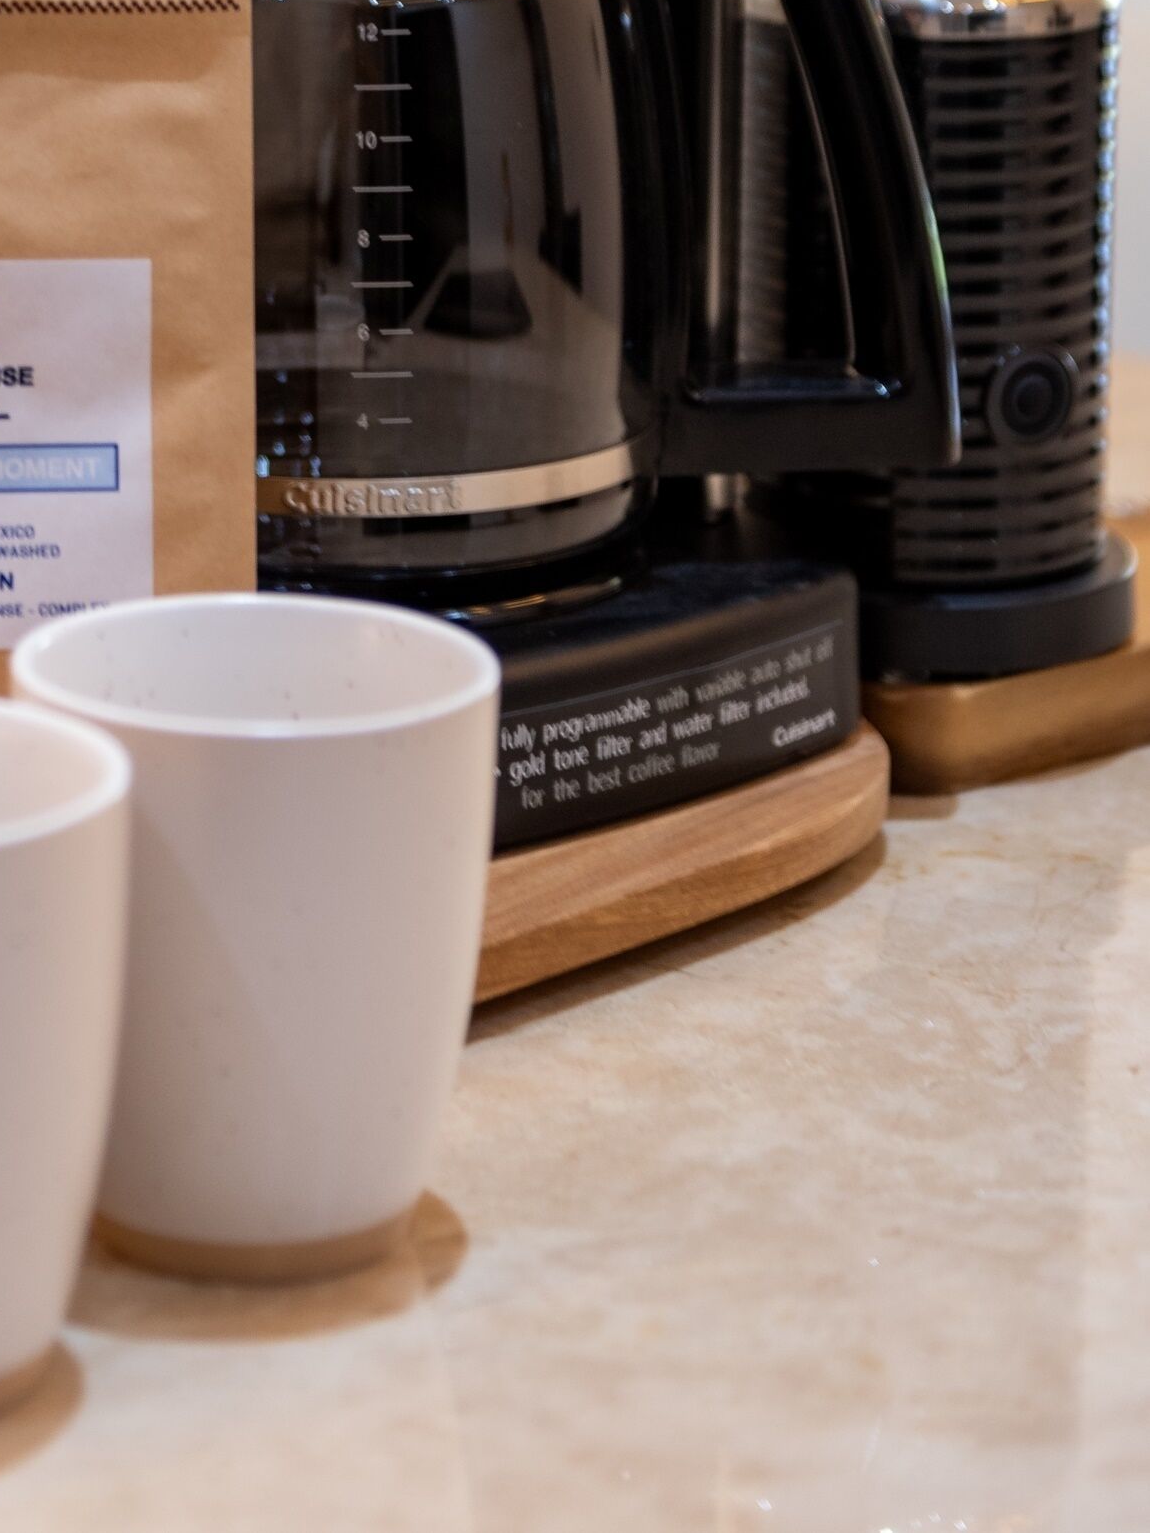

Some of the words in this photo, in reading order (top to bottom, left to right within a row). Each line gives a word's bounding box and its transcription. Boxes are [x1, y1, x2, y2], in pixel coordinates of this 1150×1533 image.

[358, 23, 378, 41] 12
[356, 131, 377, 149] 10
[358, 230, 370, 248] 8
[358, 323, 370, 341] 6
[357, 413, 369, 430] 4
[284, 479, 462, 515] Cuisinart
[501, 723, 537, 753] fully
[542, 696, 651, 746] programmable
[656, 685, 690, 714] with
[772, 708, 837, 748] Cuisinart
[509, 750, 547, 787] gold
[553, 745, 590, 771] tone
[596, 734, 634, 761] filter
[638, 720, 668, 750] and
[671, 713, 714, 741] water
[719, 700, 751, 726] filter
[521, 785, 546, 810] for
[553, 777, 581, 802] the
[587, 766, 622, 795] best
[627, 752, 676, 784] coffee
